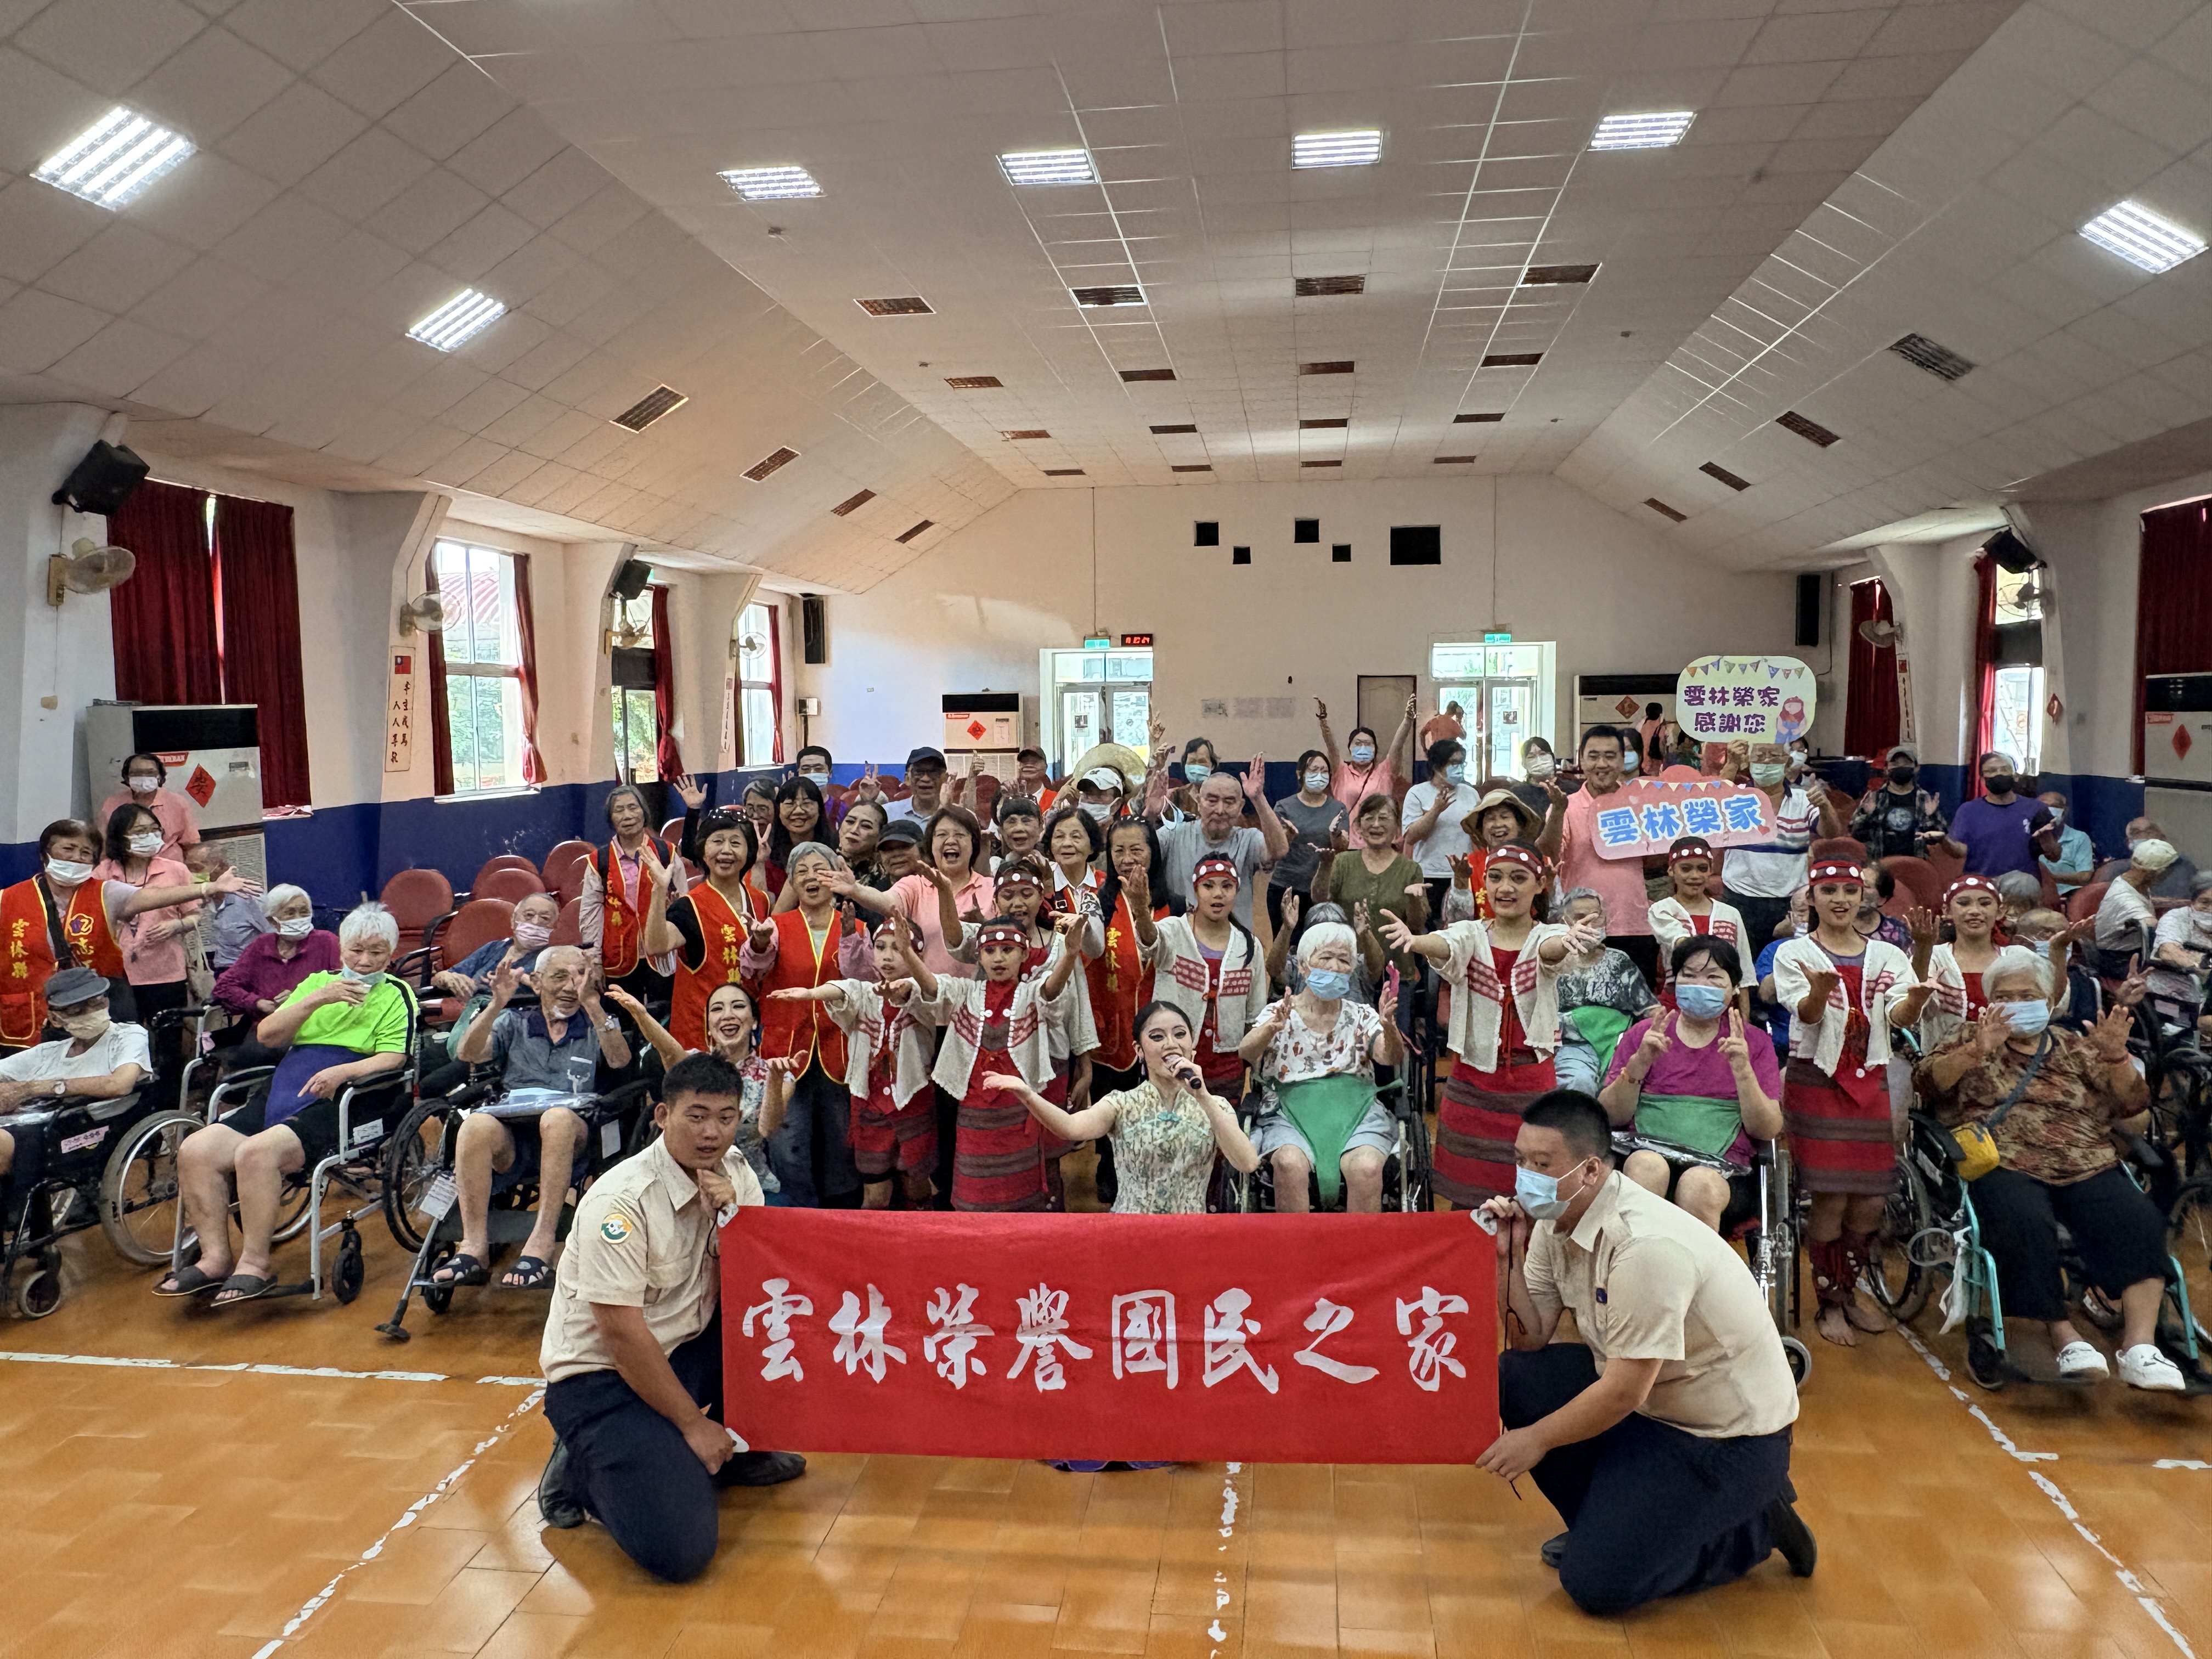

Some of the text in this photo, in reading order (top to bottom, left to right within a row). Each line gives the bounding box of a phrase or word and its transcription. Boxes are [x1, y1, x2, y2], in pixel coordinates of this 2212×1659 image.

[1684, 685, 1780, 707] 雲林榮家
[1694, 712, 1765, 734] 感謝您
[1599, 795, 1762, 845] 雲林榮家
[743, 1278, 1470, 1394] 雲林榮譽國民之家
